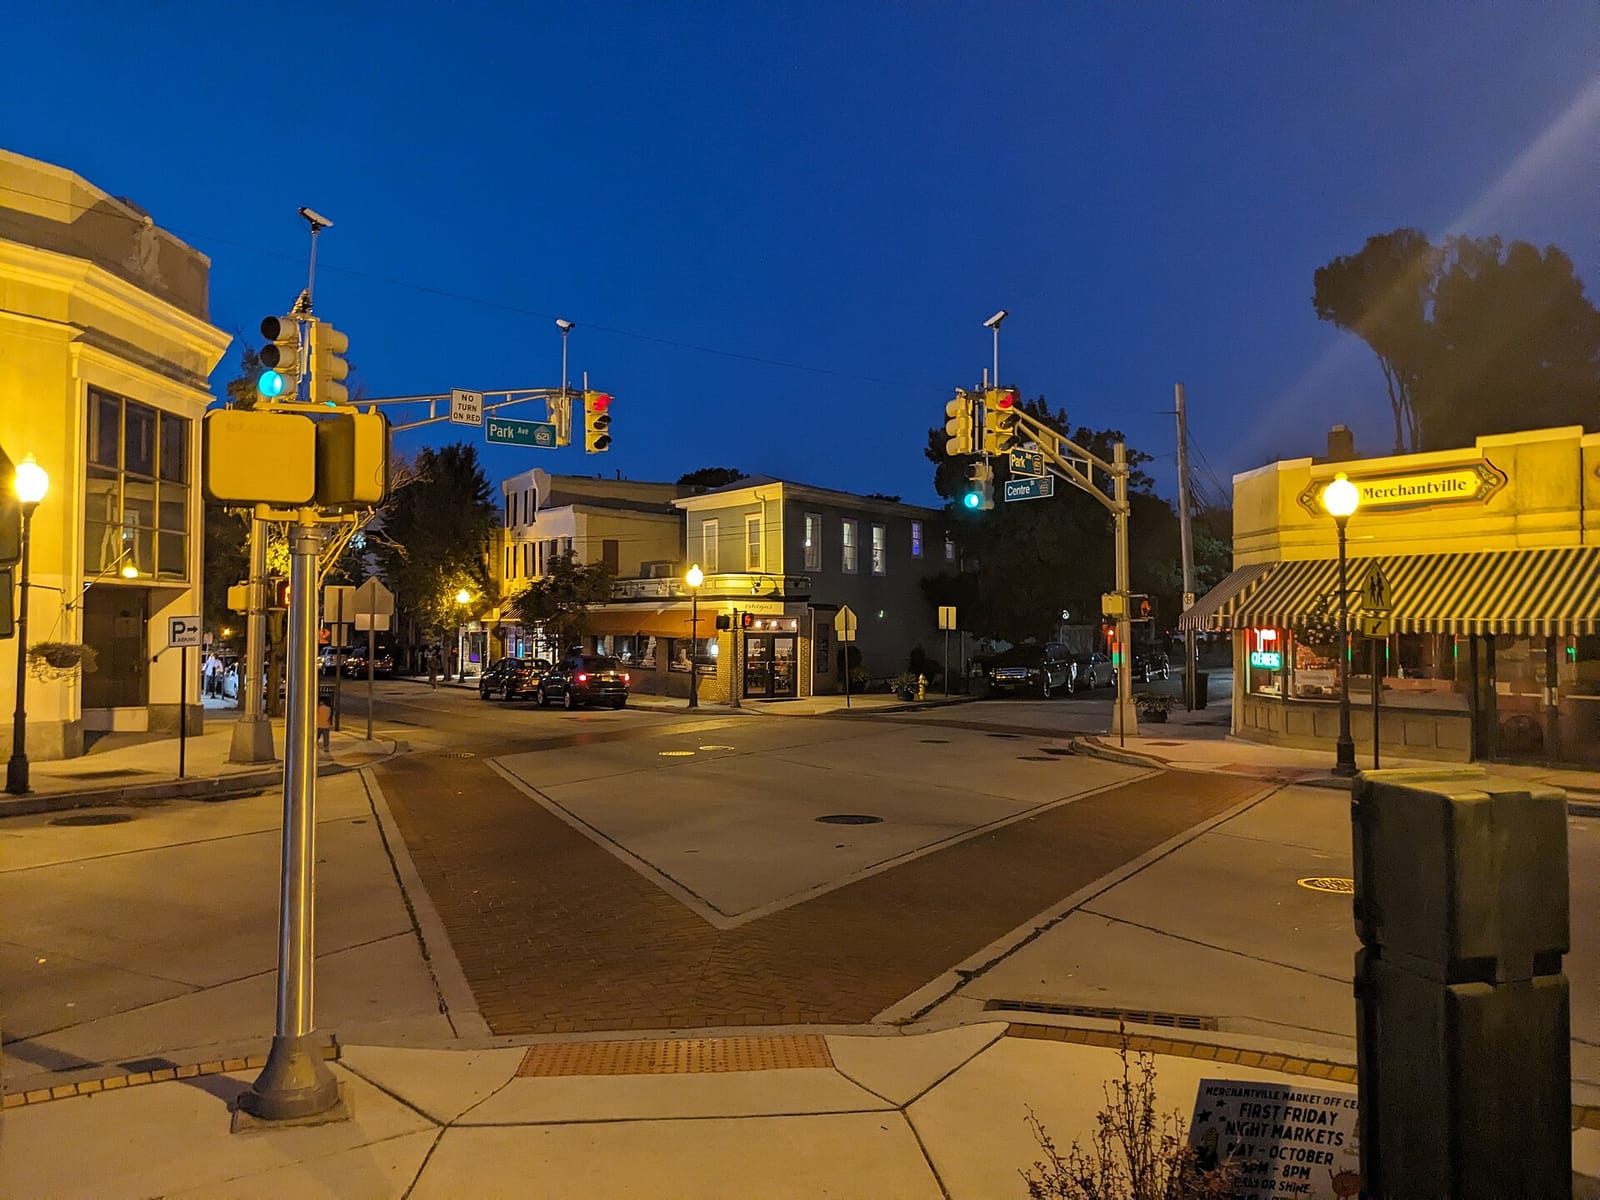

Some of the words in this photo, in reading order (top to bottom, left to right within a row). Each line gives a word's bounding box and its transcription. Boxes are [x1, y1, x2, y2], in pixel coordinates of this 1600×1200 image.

[461, 394, 474, 402] NO
[457, 403, 477, 412] TURN
[453, 412, 464, 420] ON
[466, 414, 481, 422] RED
[489, 424, 514, 439] Park
[517, 427, 529, 435] Ave
[536, 432, 550, 441] 621
[1011, 454, 1026, 468] Park
[1007, 484, 1030, 496] Centre
[1363, 479, 1467, 499] Merchantville
[1283, 1092, 1321, 1105] MARKET
[1323, 1097, 1342, 1107] OFF
[1239, 1102, 1281, 1121] FIRST
[1283, 1106, 1339, 1126] FRIDAY
[1224, 1120, 1271, 1138] NIGHT
[1271, 1124, 1344, 1146] MARKETS
[1269, 1145, 1334, 1166] OCTOBER
[1282, 1164, 1312, 1180] 8PM
[1261, 1178, 1276, 1190] OR
[1278, 1180, 1310, 1193] SHINE
